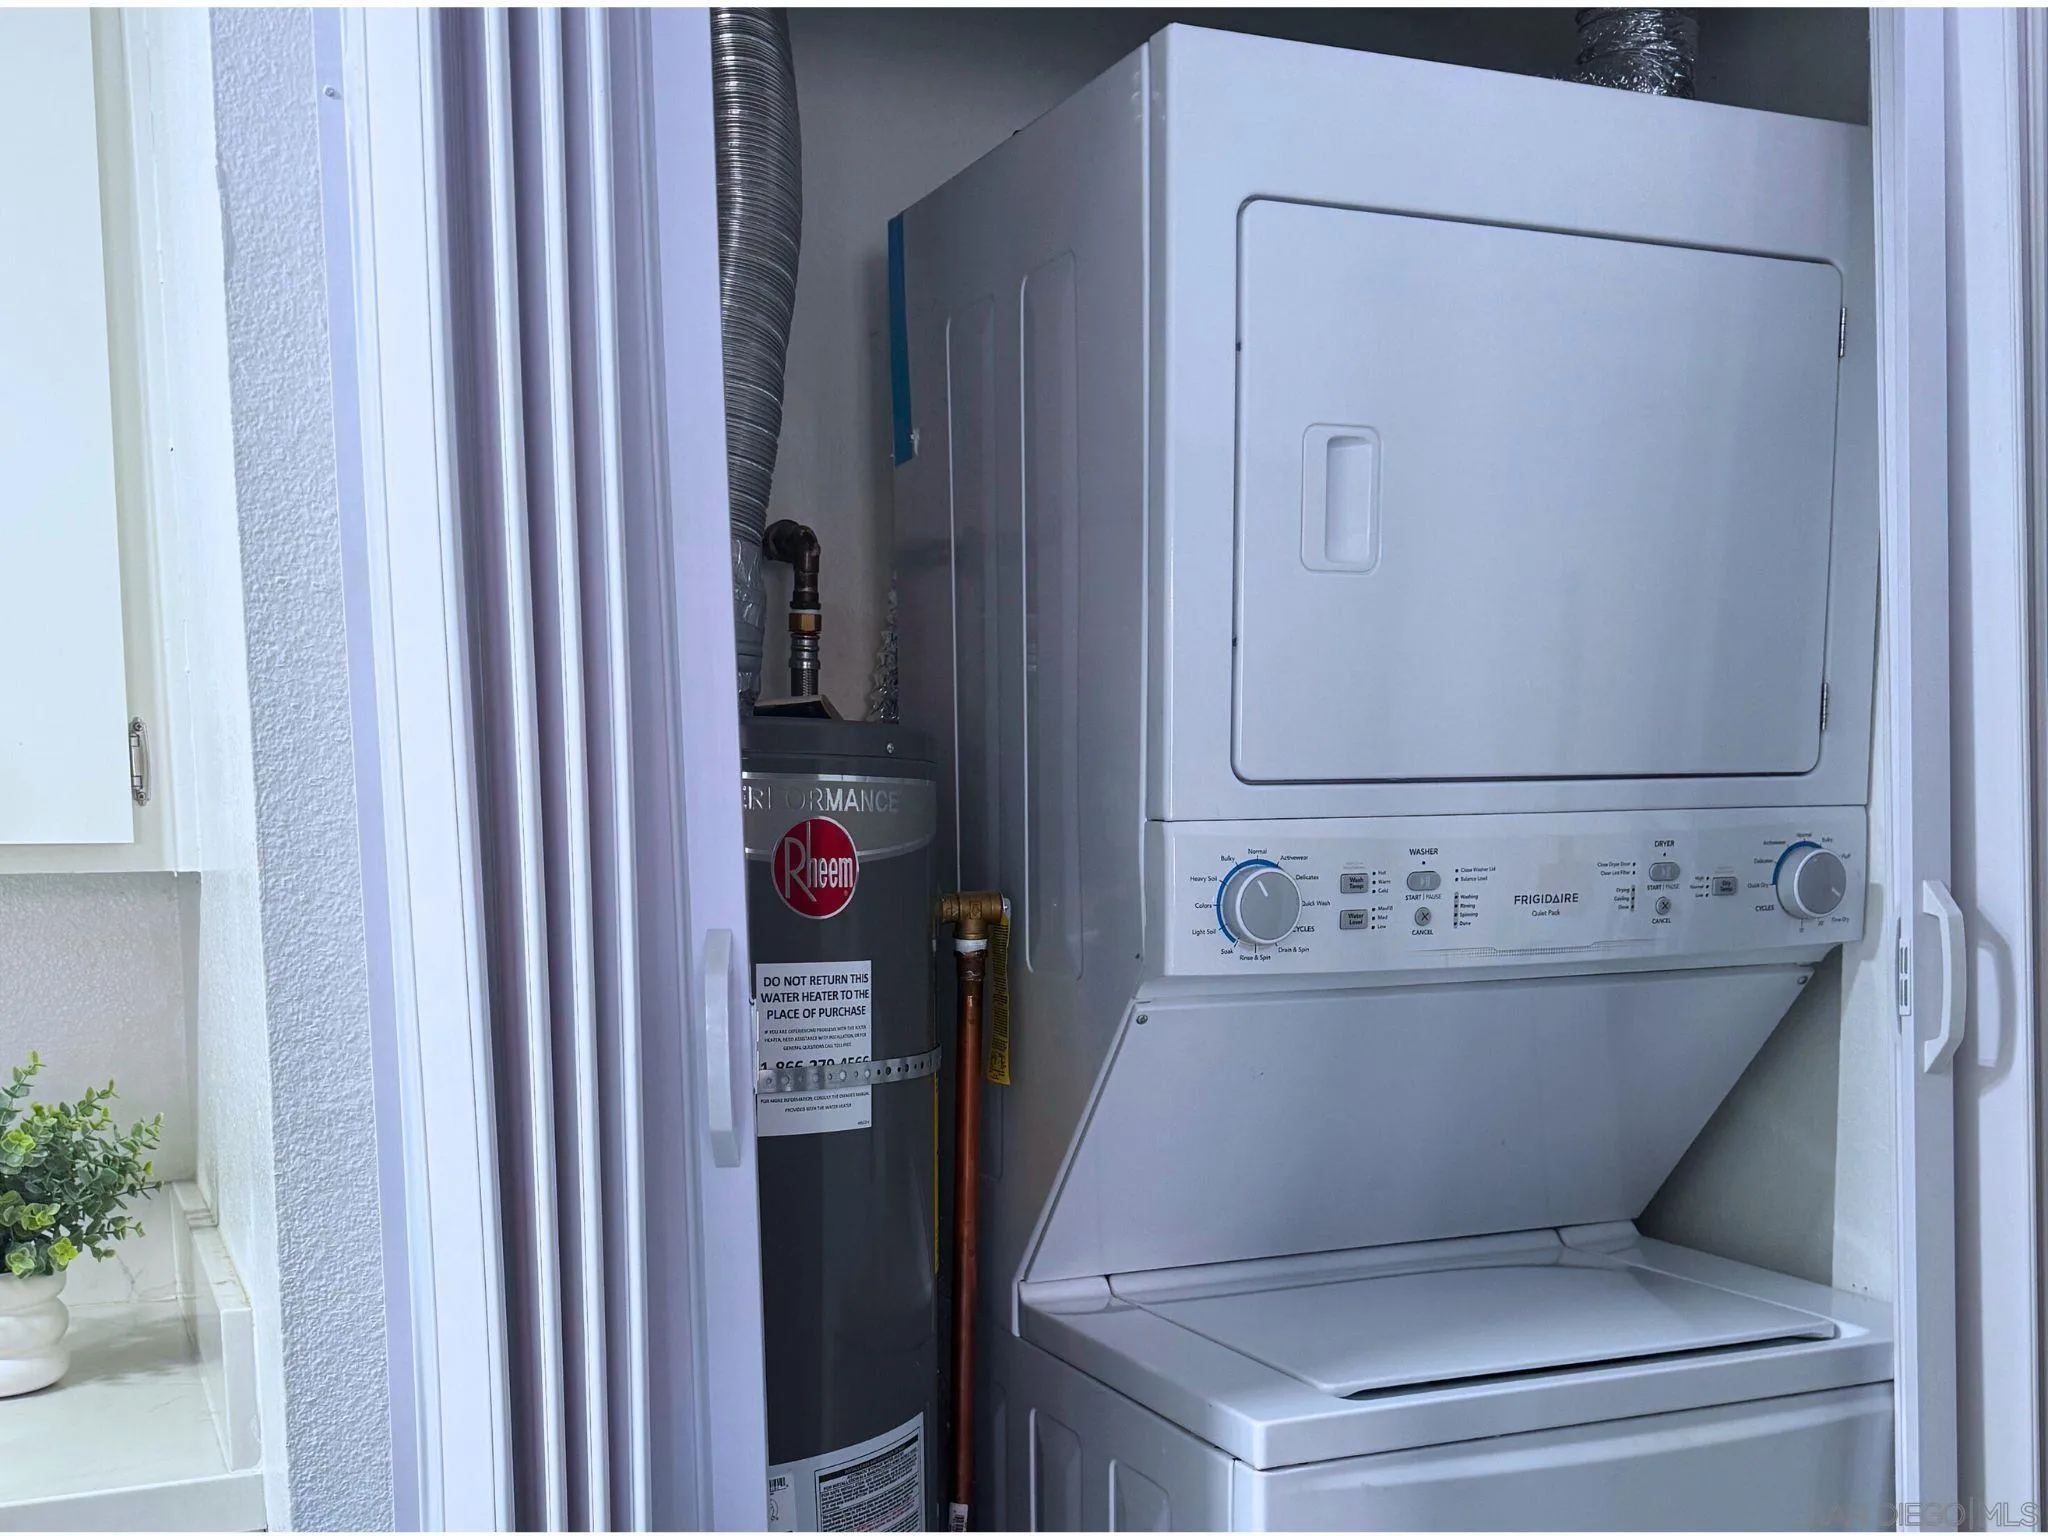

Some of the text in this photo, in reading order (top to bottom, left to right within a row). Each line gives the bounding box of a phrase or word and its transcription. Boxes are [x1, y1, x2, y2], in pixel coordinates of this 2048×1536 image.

[1409, 848, 1438, 856] WASHER
[784, 821, 854, 902] Rheem
[1514, 892, 1579, 905] FRIGIDAIRE
[1532, 908, 1560, 918] Quiet Pack
[764, 973, 869, 987] DO NOT RETURN THIS
[761, 989, 869, 1003] WATER HEATER TO THE
[767, 1005, 867, 1020] PLACE OF PURCHASE
